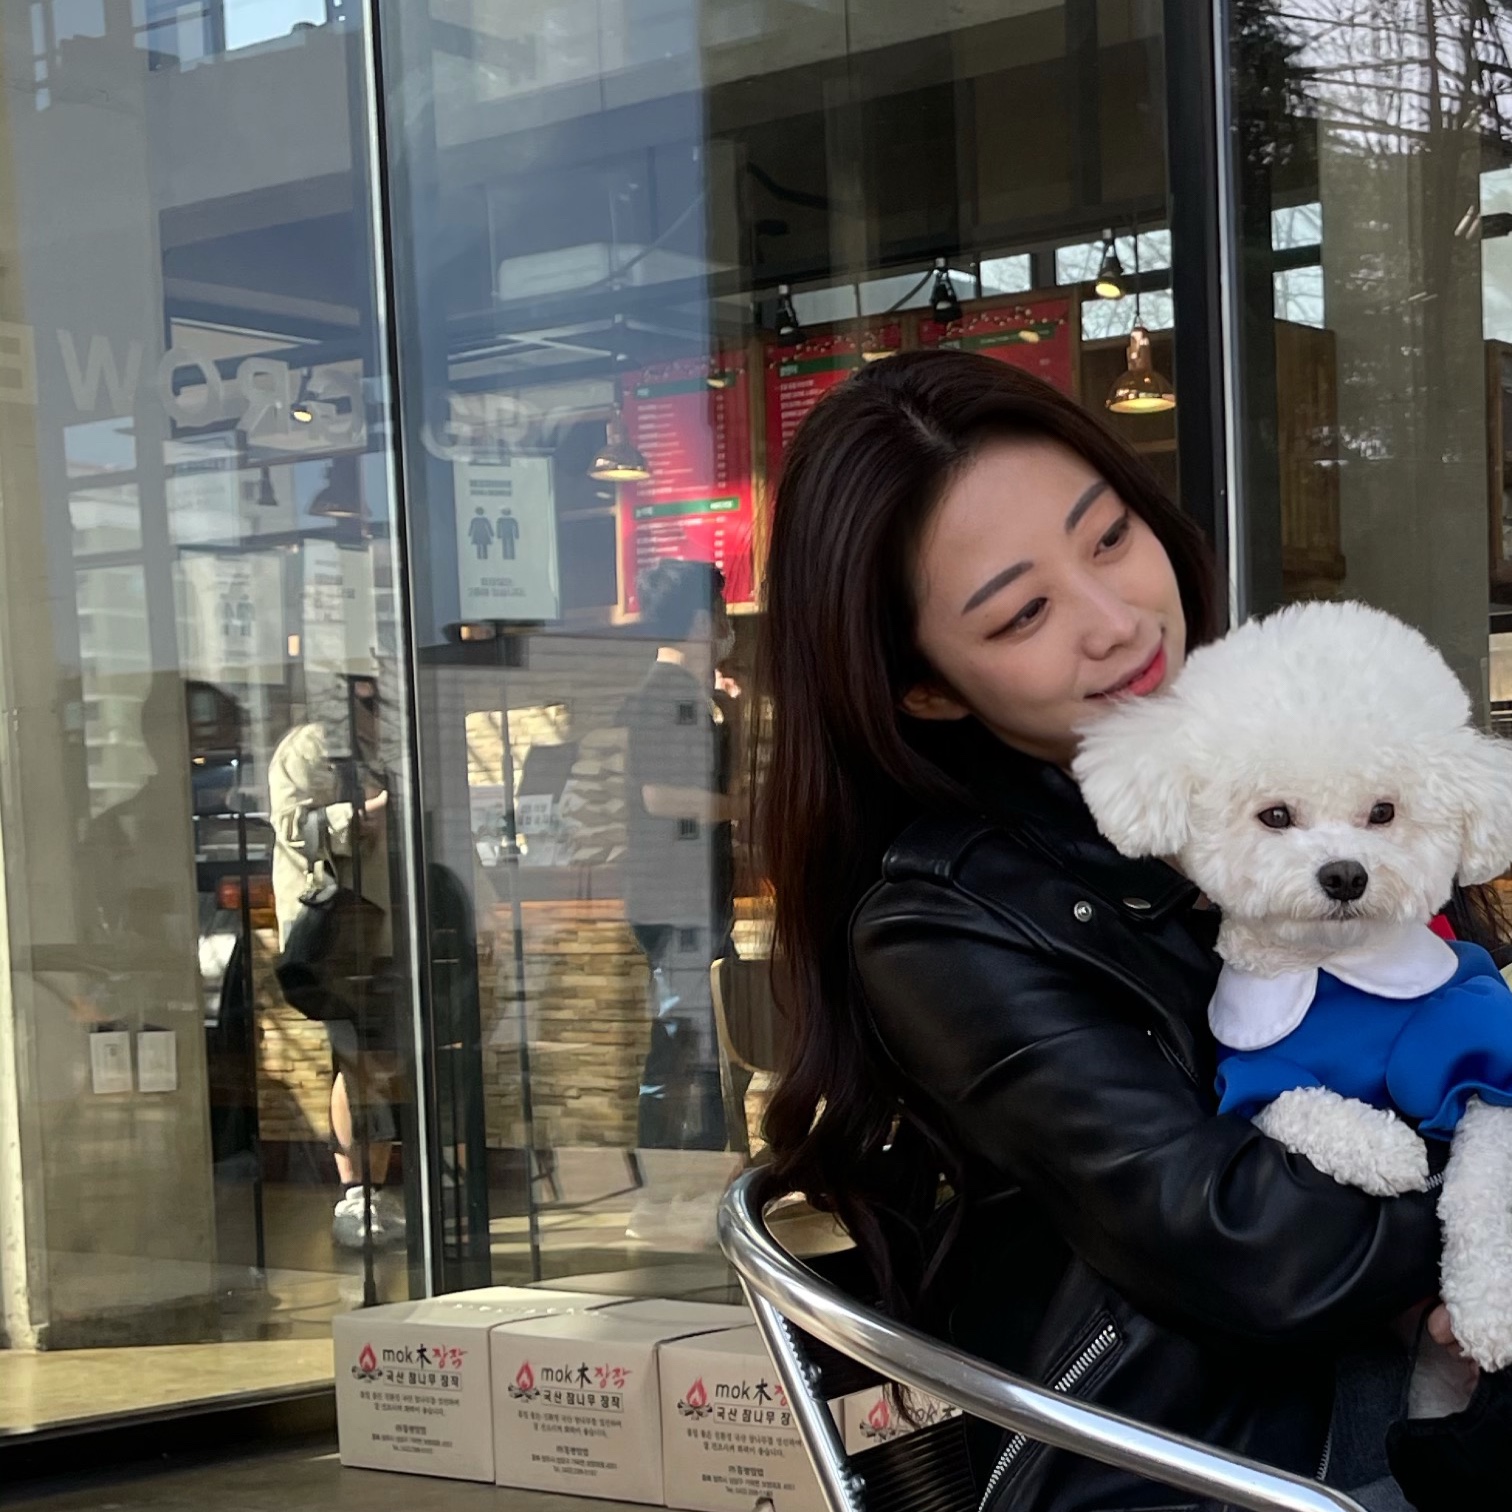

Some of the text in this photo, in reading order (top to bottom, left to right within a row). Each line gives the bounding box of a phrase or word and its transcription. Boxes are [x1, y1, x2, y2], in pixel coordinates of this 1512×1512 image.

[543, 1390, 562, 1404] 국산
[600, 1395, 620, 1409] 장작
[717, 1407, 738, 1422] 국산
[742, 1409, 775, 1424] 참나무
